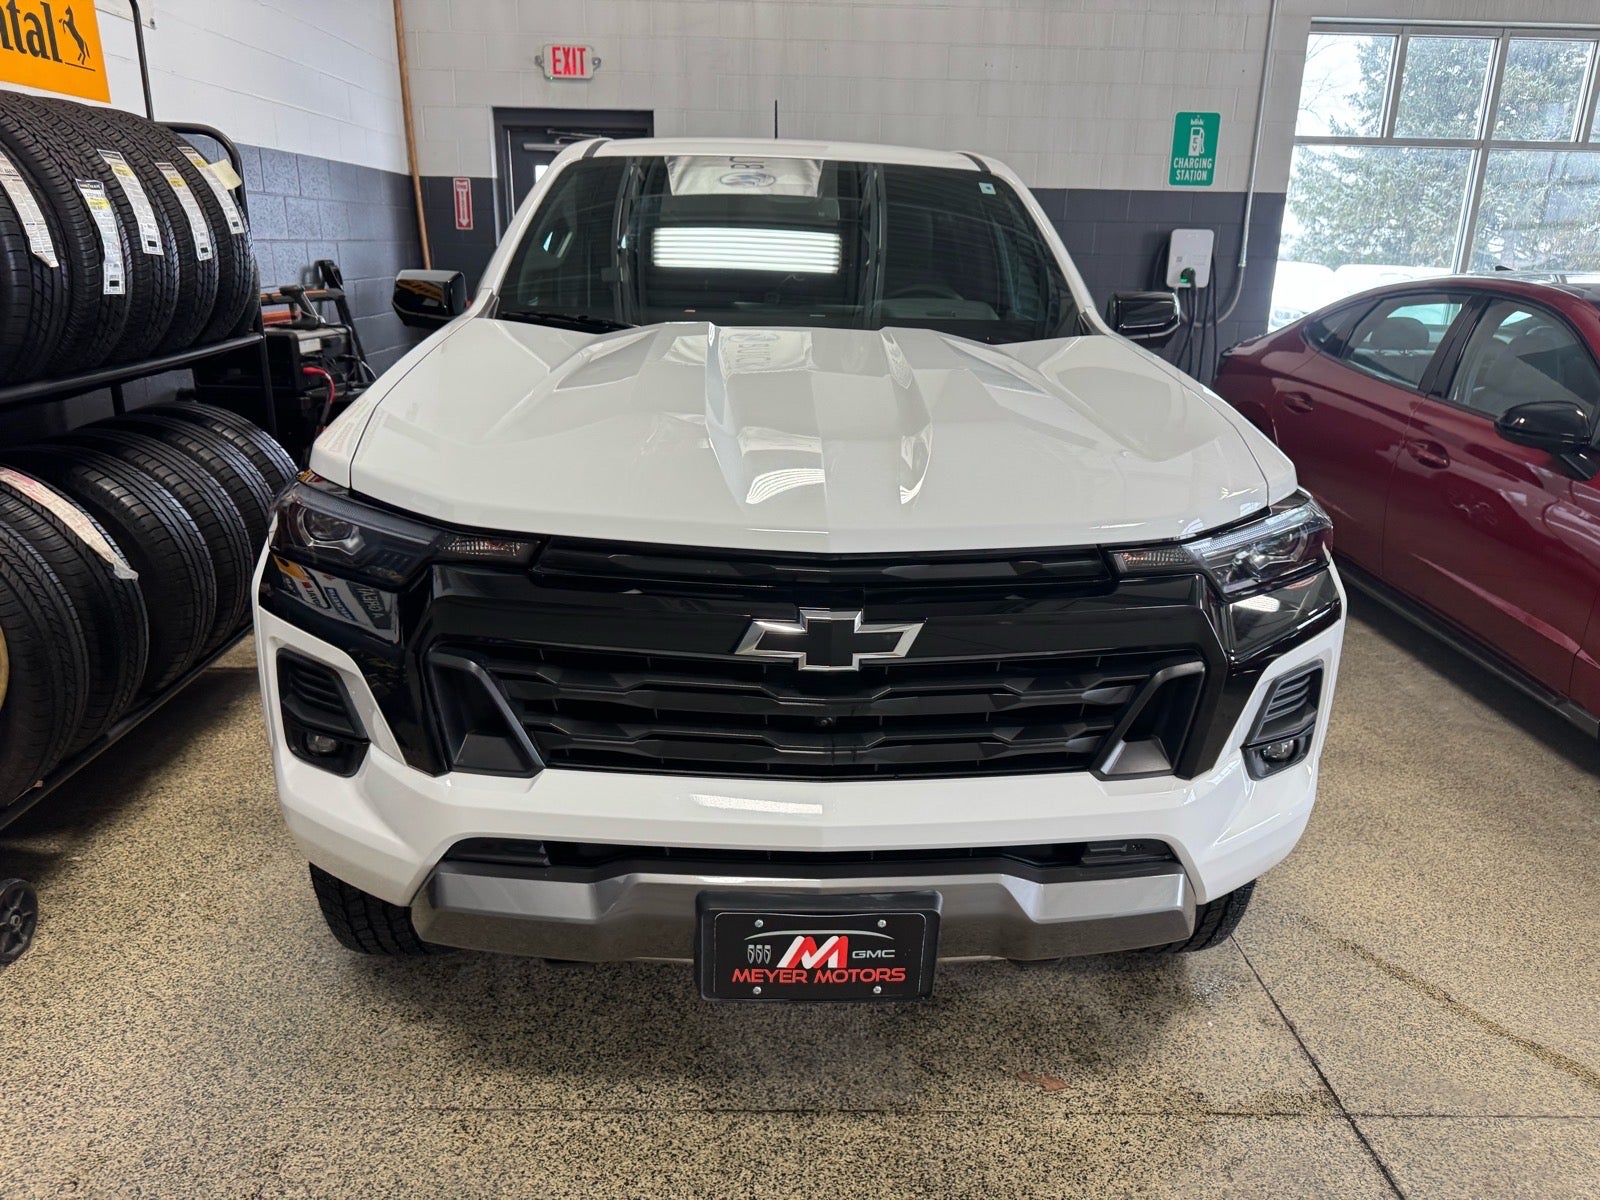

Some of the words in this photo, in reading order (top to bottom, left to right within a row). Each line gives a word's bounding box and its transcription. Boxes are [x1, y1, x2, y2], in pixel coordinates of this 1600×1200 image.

[552, 46, 586, 76] EXIT
[1173, 157, 1213, 169] CHARGING
[1175, 170, 1208, 182] STATION
[851, 949, 896, 959] GMC
[731, 968, 808, 984] MEYER
[813, 967, 906, 984] MOTORS
